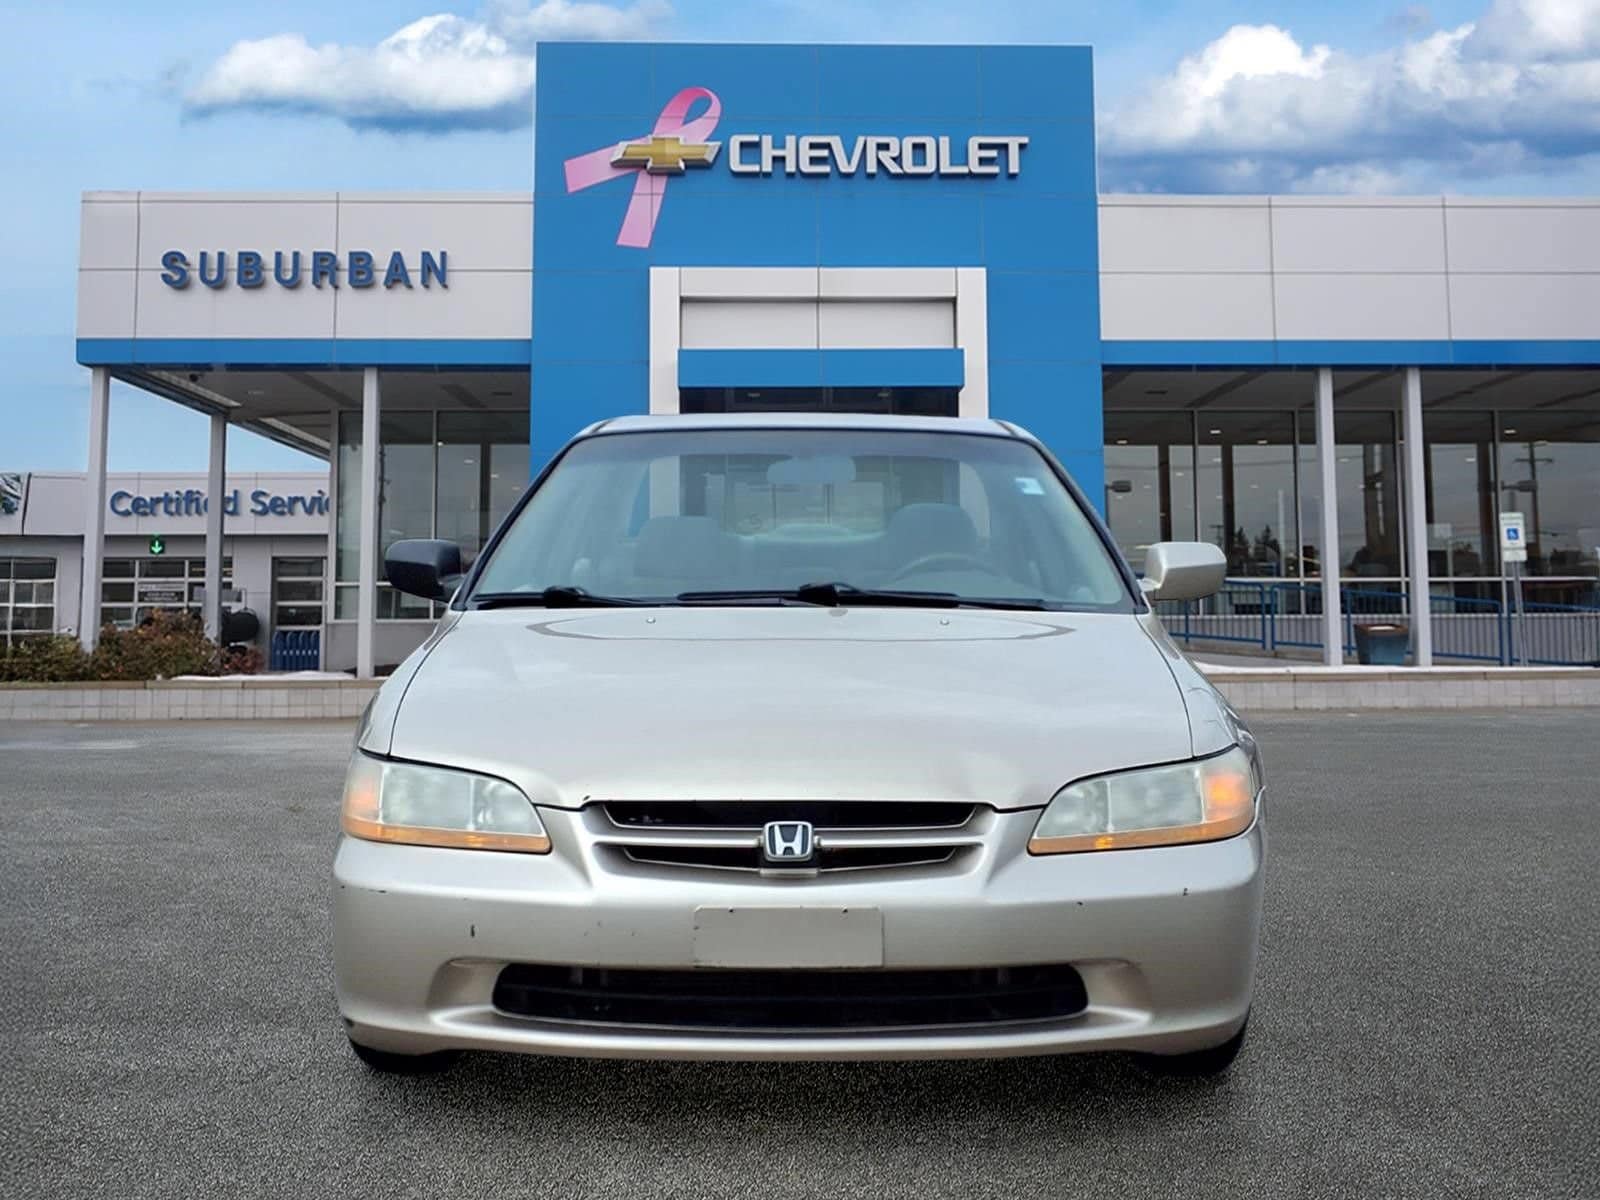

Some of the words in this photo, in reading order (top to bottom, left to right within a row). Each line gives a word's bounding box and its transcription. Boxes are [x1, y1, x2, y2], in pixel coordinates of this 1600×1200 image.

[729, 134, 1030, 176] CHEVROLET
[160, 250, 449, 289] SUBURBAN
[109, 489, 240, 517] Certifid
[250, 489, 330, 517] Servi
